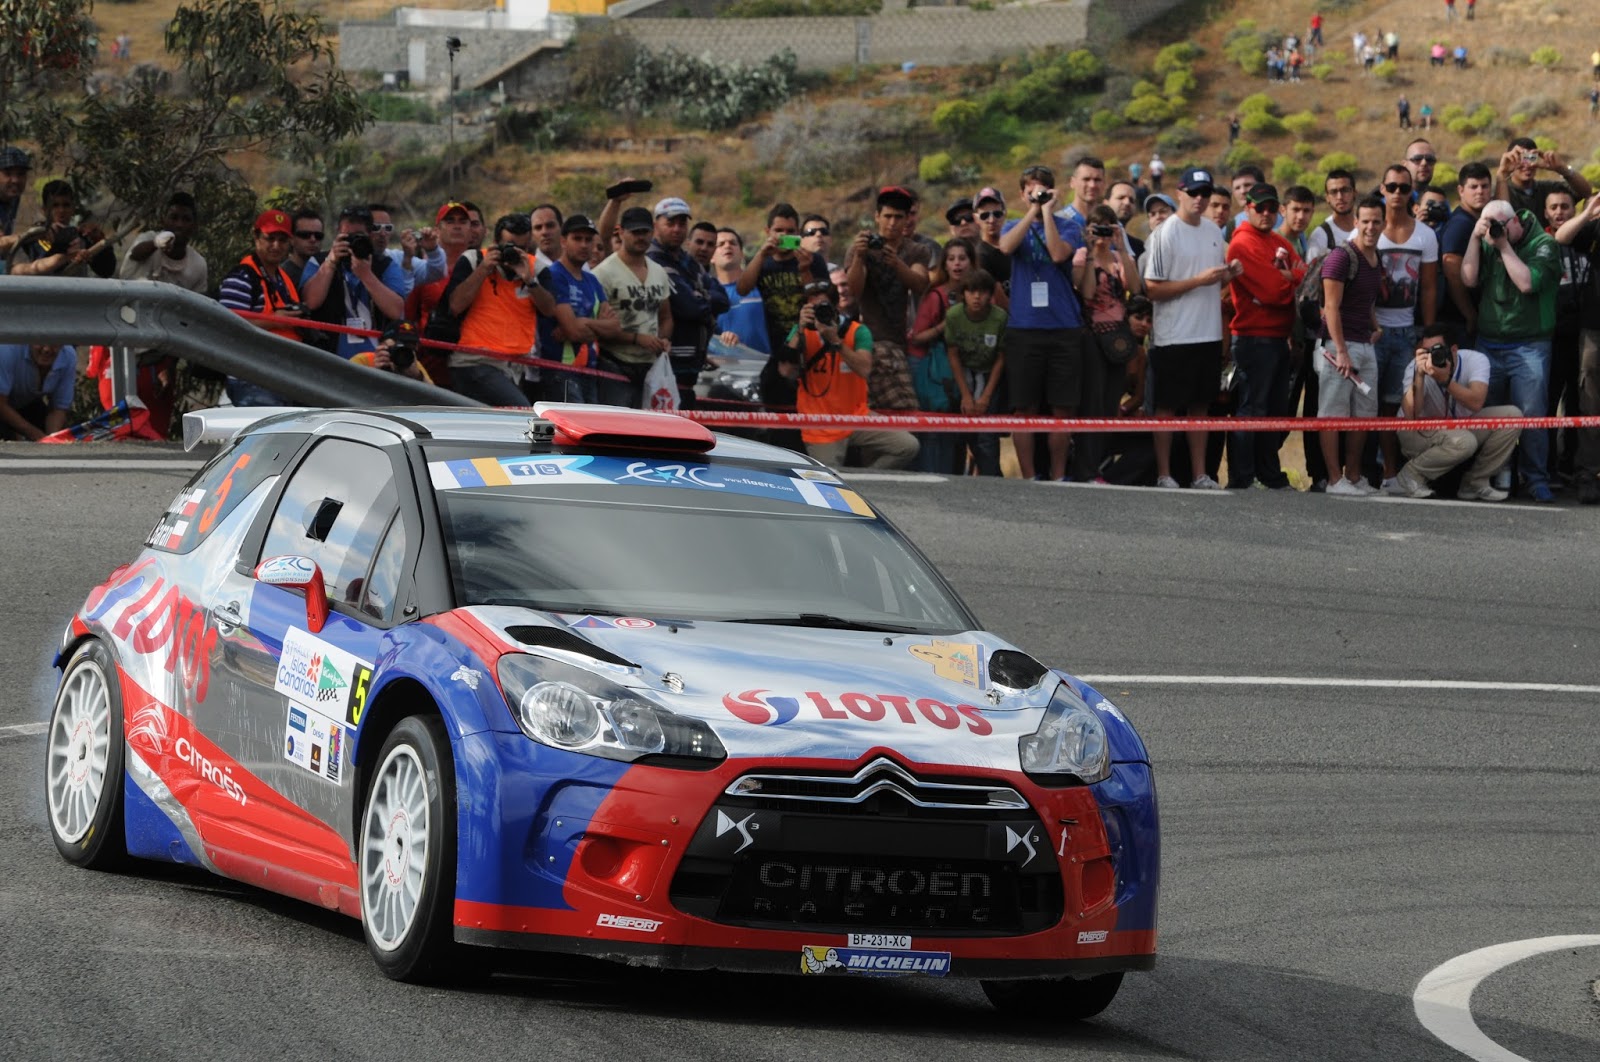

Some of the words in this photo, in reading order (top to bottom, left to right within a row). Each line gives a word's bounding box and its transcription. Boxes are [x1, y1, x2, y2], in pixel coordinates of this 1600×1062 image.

[723, 476, 795, 492] www.fiaerc.com
[111, 576, 218, 704] LOTOS
[278, 664, 316, 699] Canarias
[352, 668, 371, 725] 5
[805, 691, 993, 736] LOTOS
[852, 934, 908, 947] BF-231-XC
[847, 955, 947, 971] MICHELIN
